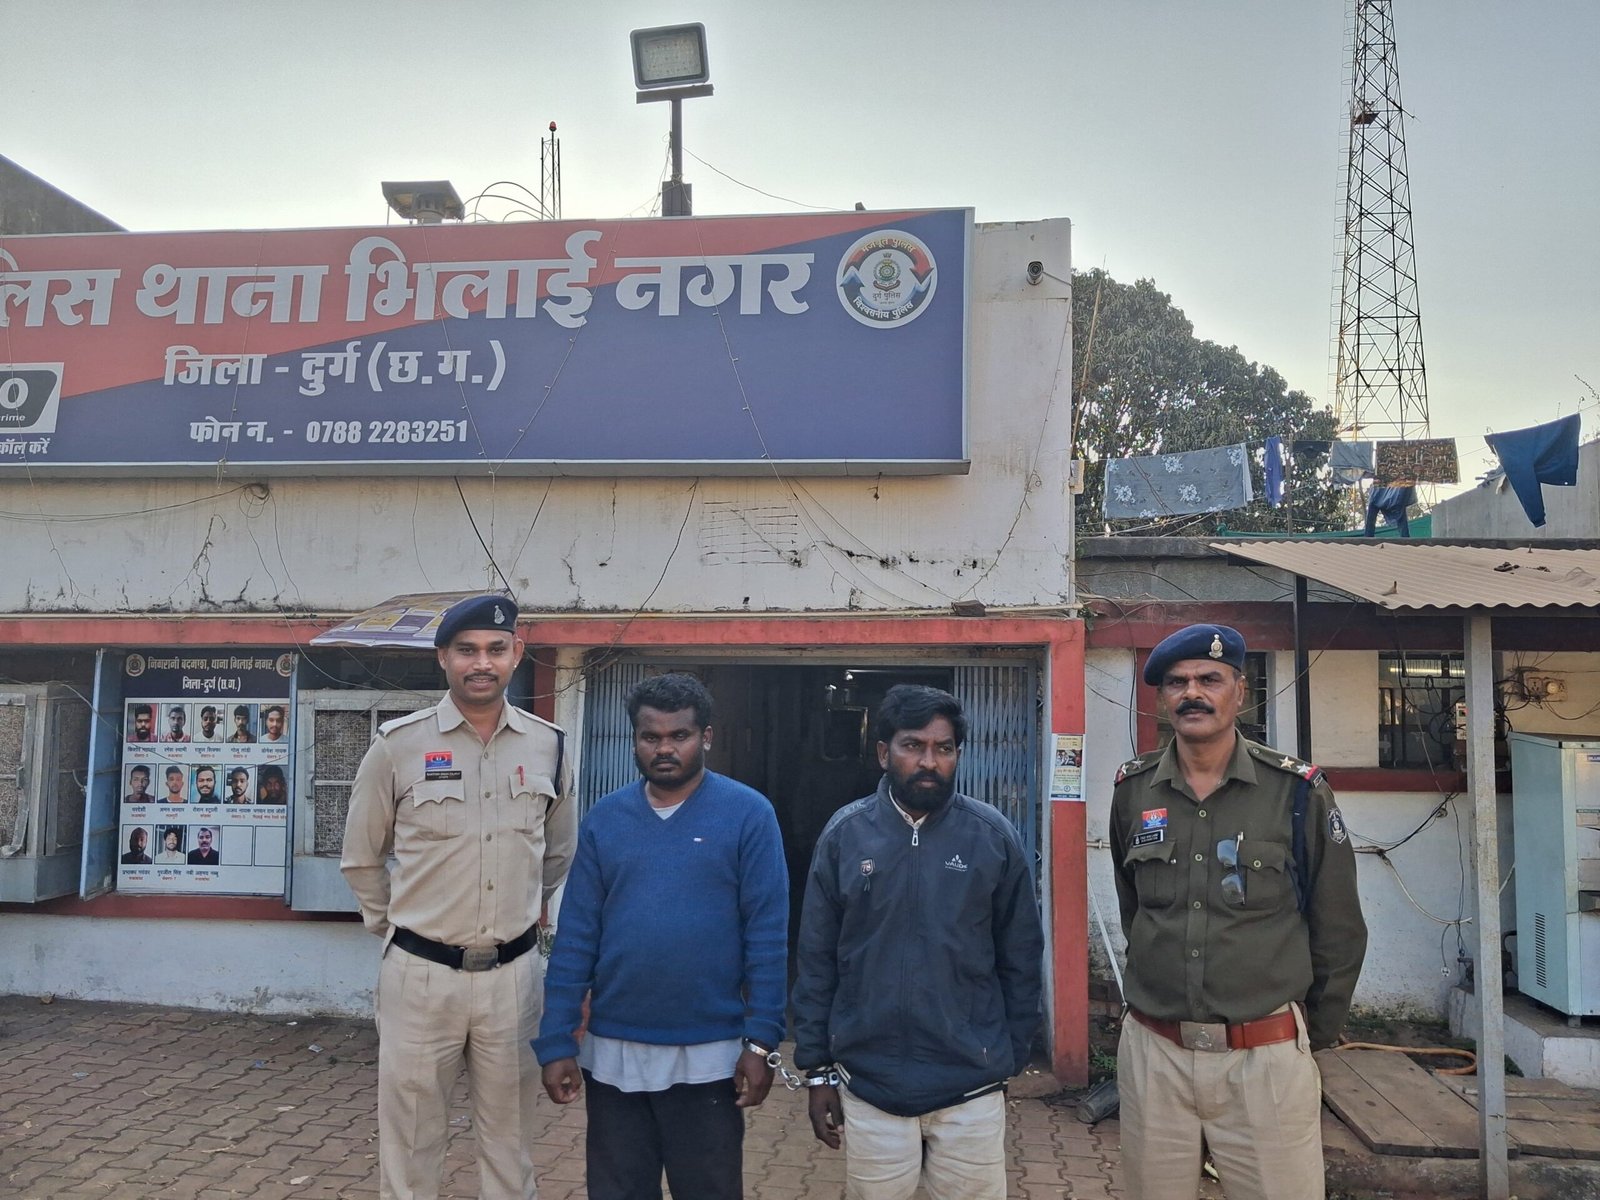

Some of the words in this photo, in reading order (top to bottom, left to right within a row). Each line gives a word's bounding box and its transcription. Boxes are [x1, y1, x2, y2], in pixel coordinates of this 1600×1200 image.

[892, 238, 916, 252] पुलिस
[135, 263, 329, 325] थाना
[345, 230, 603, 329] भिलाई
[614, 253, 815, 316] नगर
[891, 301, 914, 319] पुलिस
[164, 345, 268, 386] जिला
[299, 341, 362, 396] दुर्ग
[0, 413, 26, 422] rime
[189, 416, 241, 443] फोन
[306, 420, 362, 444] 0788
[368, 420, 468, 443] 2283251
[29, 437, 51, 454] करें
